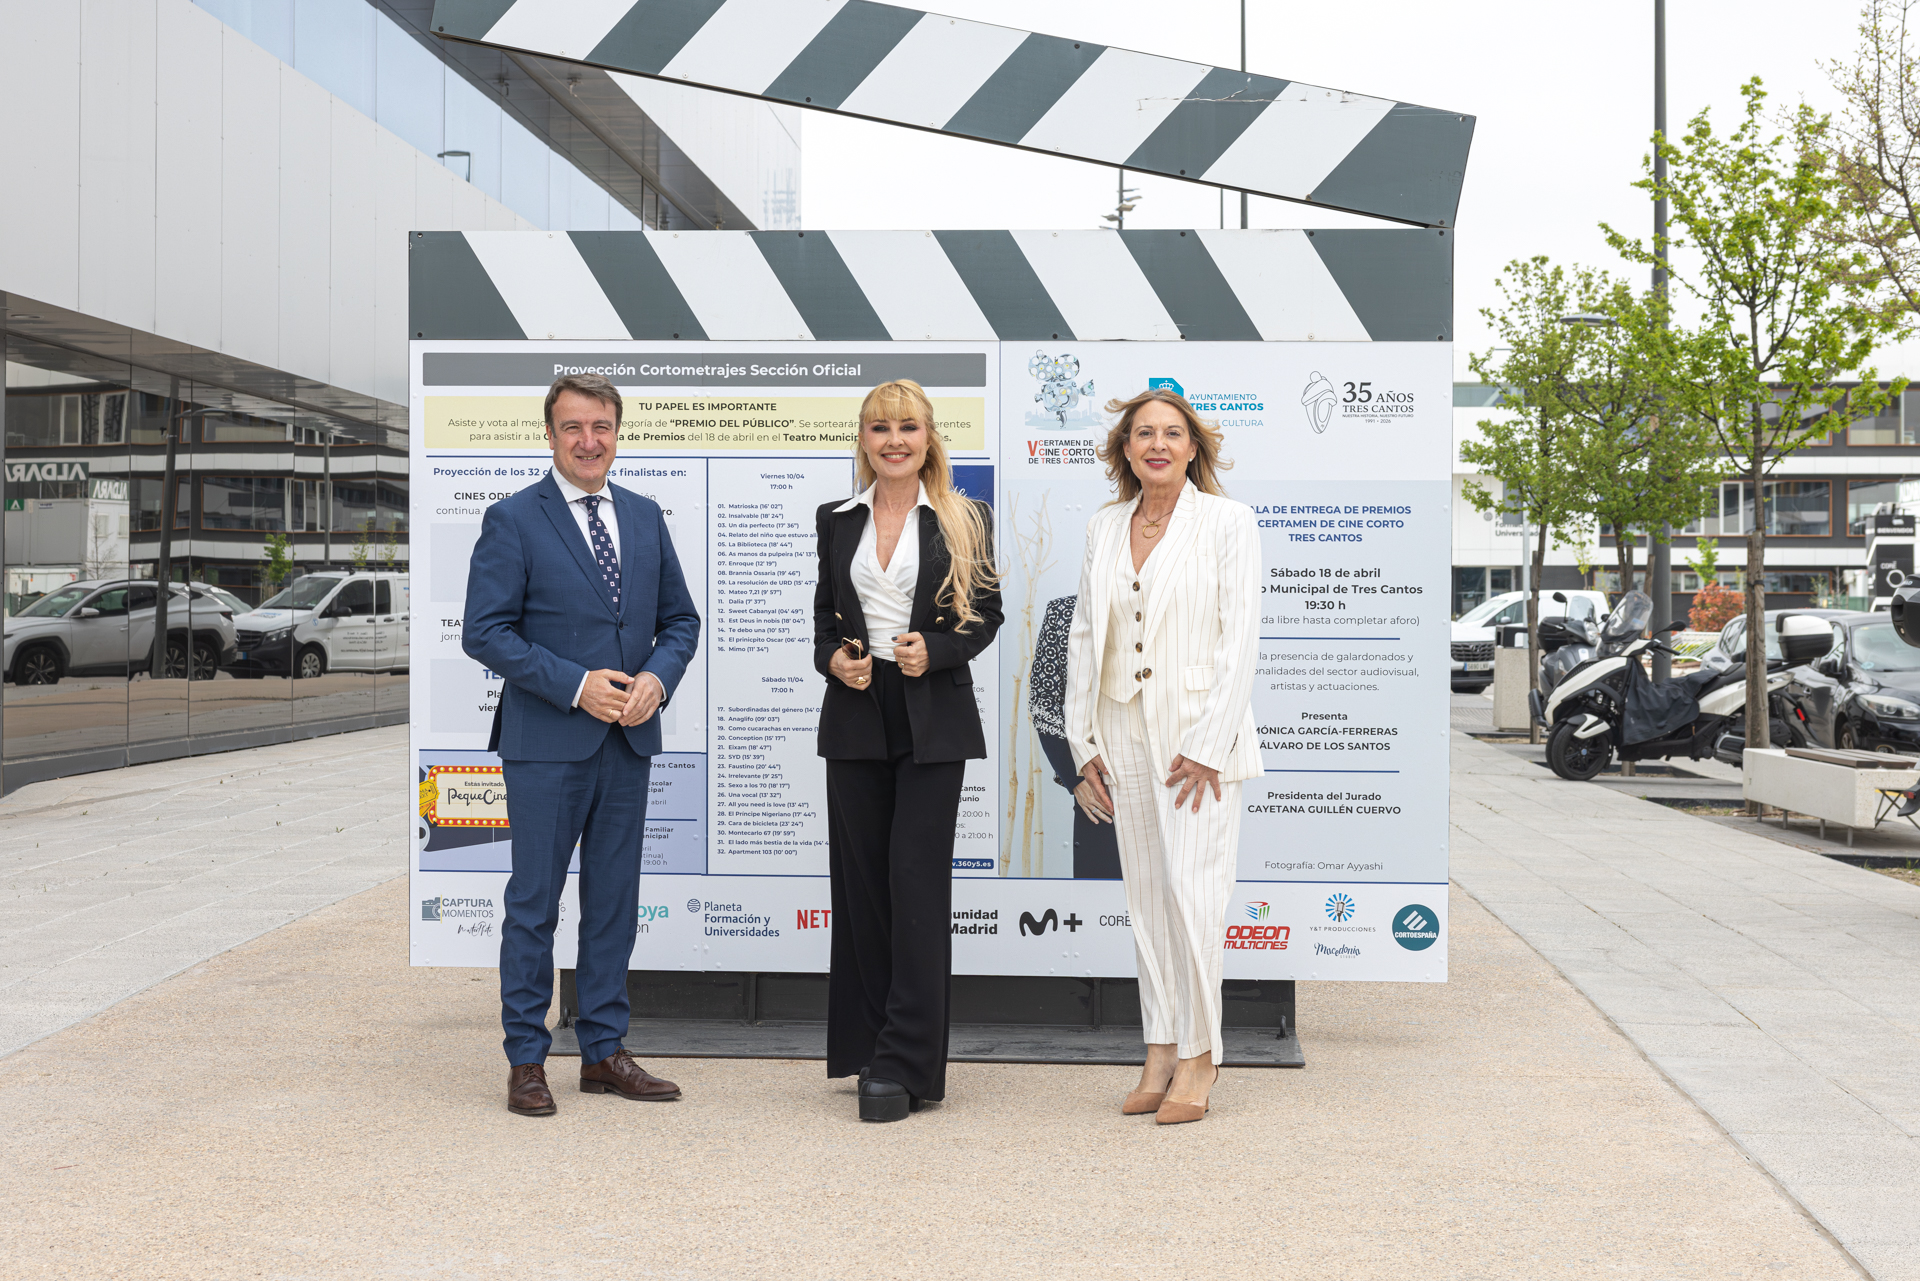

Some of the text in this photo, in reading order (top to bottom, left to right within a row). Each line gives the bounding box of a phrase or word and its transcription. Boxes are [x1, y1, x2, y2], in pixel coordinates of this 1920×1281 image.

[639, 363, 747, 379] Cortometrajes
[750, 362, 808, 376] Sección
[812, 362, 861, 376] Oficial
[1189, 393, 1257, 401] AYUNTAMIENTO
[1343, 381, 1414, 403] 35 AÑOS
[639, 402, 777, 411] TU PAPEL ES IMPORTANTE
[1190, 403, 1264, 411] TRES CANTOS
[1343, 405, 1414, 413] TRES CANTOS
[448, 419, 477, 427] Asiste
[479, 420, 486, 429] y
[487, 419, 508, 427] vota
[510, 419, 519, 427] al
[521, 419, 546, 429] mejo
[620, 419, 653, 429] egoría
[655, 419, 668, 428] de
[670, 419, 716, 428] “PREMIO
[719, 419, 740, 428] DEL
[798, 419, 811, 428] Se
[1222, 419, 1264, 427] CULTURA
[470, 433, 491, 442] para
[493, 432, 522, 441] asistir
[533, 432, 541, 441] la
[627, 433, 640, 441] de
[643, 432, 685, 441] Premios
[688, 433, 702, 441] del
[705, 433, 715, 441] 18
[718, 433, 730, 441] de
[733, 433, 755, 442] abril
[757, 434, 770, 442] en
[772, 433, 781, 442] el
[783, 433, 817, 442] Teatro
[1039, 439, 1094, 447] CERTAMEN DE
[1027, 440, 1038, 457] V
[1039, 448, 1095, 456] CINE CORTO
[1028, 457, 1095, 465] DE TRES CANTOS
[433, 467, 491, 477] Proyección
[494, 468, 507, 476] de
[510, 468, 525, 476] los
[528, 468, 540, 476] 32
[620, 468, 668, 477] finalistas
[670, 469, 687, 477] en:
[454, 492, 485, 500] CINES
[436, 507, 483, 515] continua.
[1272, 506, 1411, 514] DE ENTREGA DE PREMIOS
[749, 522, 775, 530] perfecto
[1258, 519, 1404, 528] CERTAMEN DE CINE CORTO
[1289, 533, 1363, 542] TRES CANTOS
[1270, 567, 1381, 578] Sábado 18 de abril
[1270, 584, 1330, 596] Municipal
[1333, 584, 1349, 594] de
[1351, 585, 1377, 595] Tres
[1381, 585, 1423, 595] Cantos
[1305, 600, 1346, 610] 19:30 h
[1277, 615, 1300, 625] libre
[1303, 615, 1331, 625] hasta
[1334, 615, 1387, 627] completar
[1390, 615, 1420, 626] aforo)
[1259, 652, 1414, 663] la presencia de galardonados y
[1309, 667, 1419, 677] del sector audiovisual,
[1270, 682, 1380, 693] artistas y actuaciones.
[1301, 712, 1348, 721] Presenta
[1297, 725, 1398, 736] GARCÍA-FERRERAS
[1260, 740, 1391, 751] ÁLVARO DE LOS SANTOS
[1267, 791, 1382, 801] Presidenta del Jurado
[1247, 803, 1401, 815] CAYETANA GUILLÉN CUERVO
[1265, 861, 1383, 872] Fotografía: Omar Ayyashi
[442, 898, 493, 908] CAPTURA
[704, 901, 742, 912] Planeta
[442, 909, 494, 918] MOMENTOS
[704, 913, 771, 926] Formación y
[704, 926, 780, 937] Universidades
[1226, 925, 1291, 940] ODEON
[1394, 930, 1438, 939] CORTOESPAÑA
[1223, 940, 1288, 950] MULTICINES
[1313, 941, 1361, 956] Macedonia
